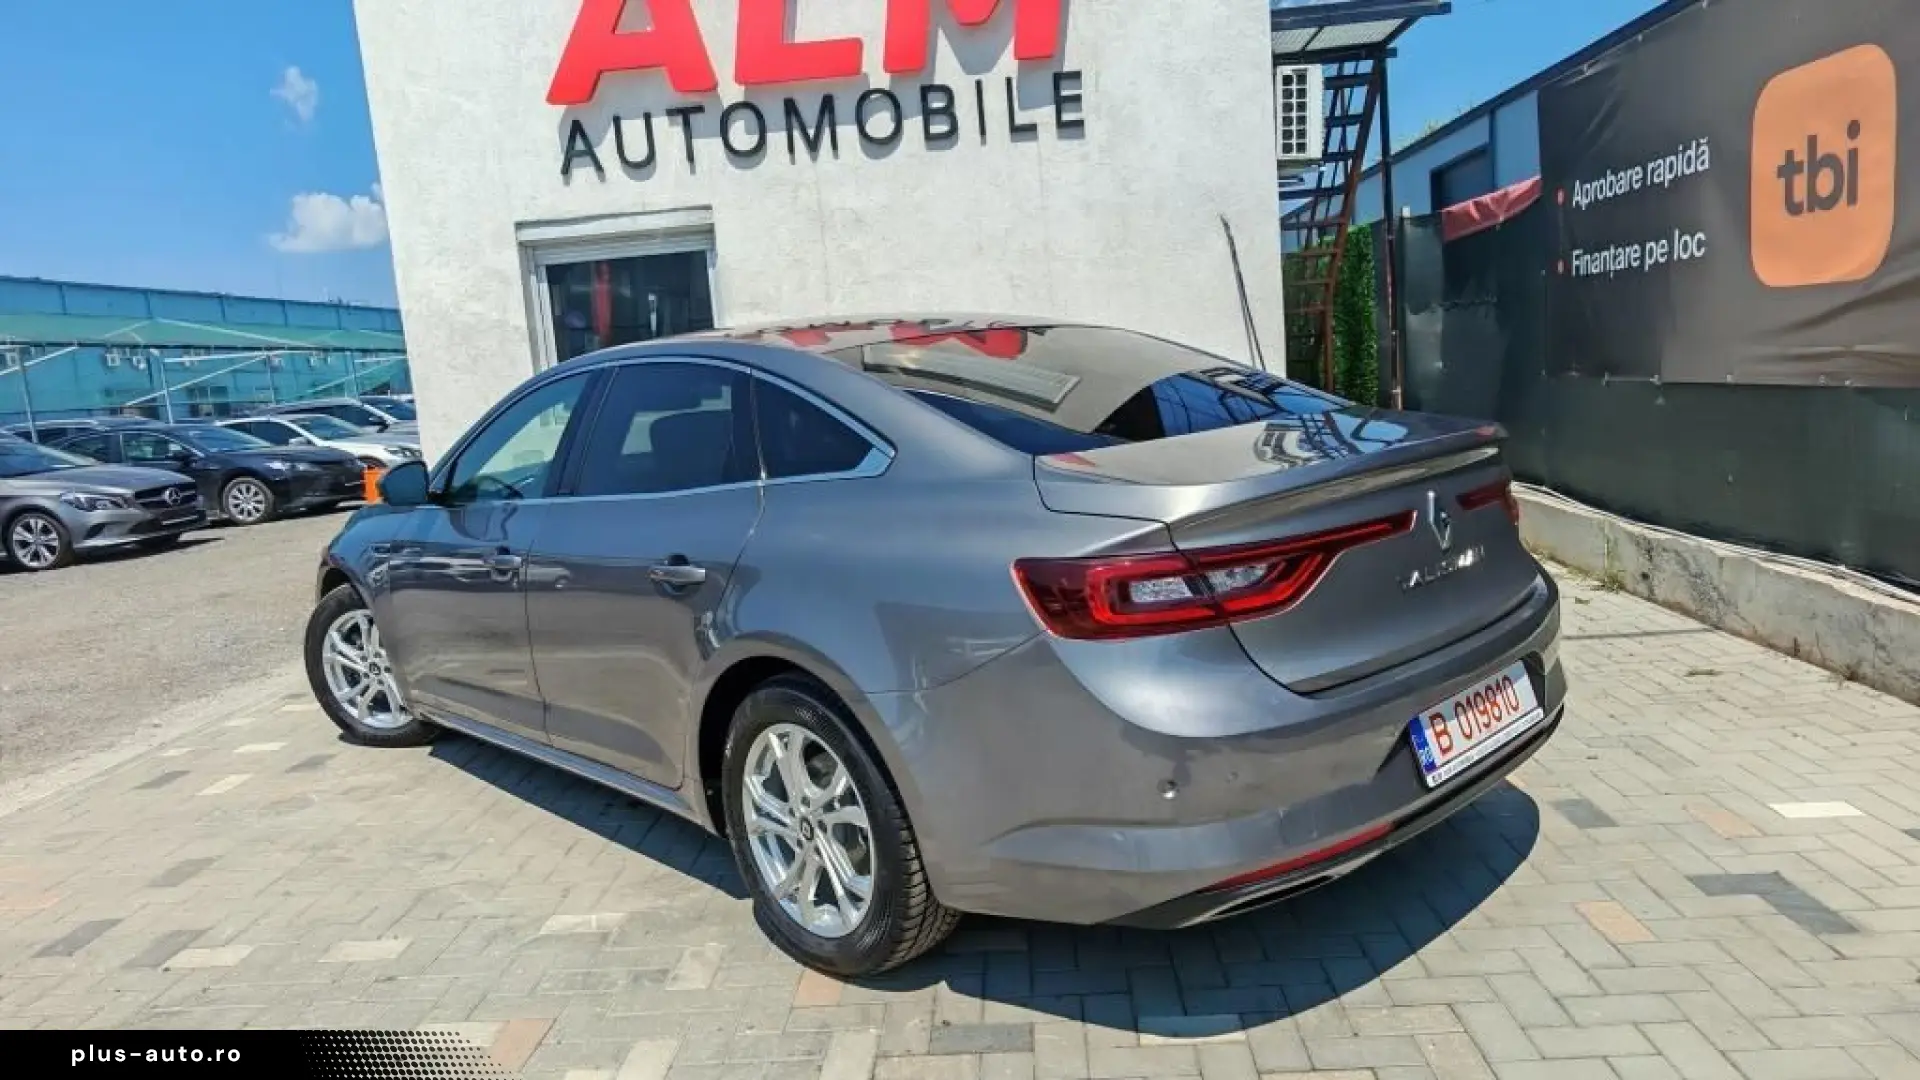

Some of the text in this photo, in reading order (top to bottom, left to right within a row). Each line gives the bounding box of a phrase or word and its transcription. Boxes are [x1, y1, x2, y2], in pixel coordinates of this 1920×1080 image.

[560, 71, 1085, 178] AUTOMOBILE
[1572, 137, 1710, 210] Aprobare rapidă
[1776, 119, 1861, 216] tbi
[1644, 239, 1668, 272] pe
[1673, 228, 1706, 261] loc
[1429, 711, 1453, 755] B
[1454, 674, 1520, 740] 019810
